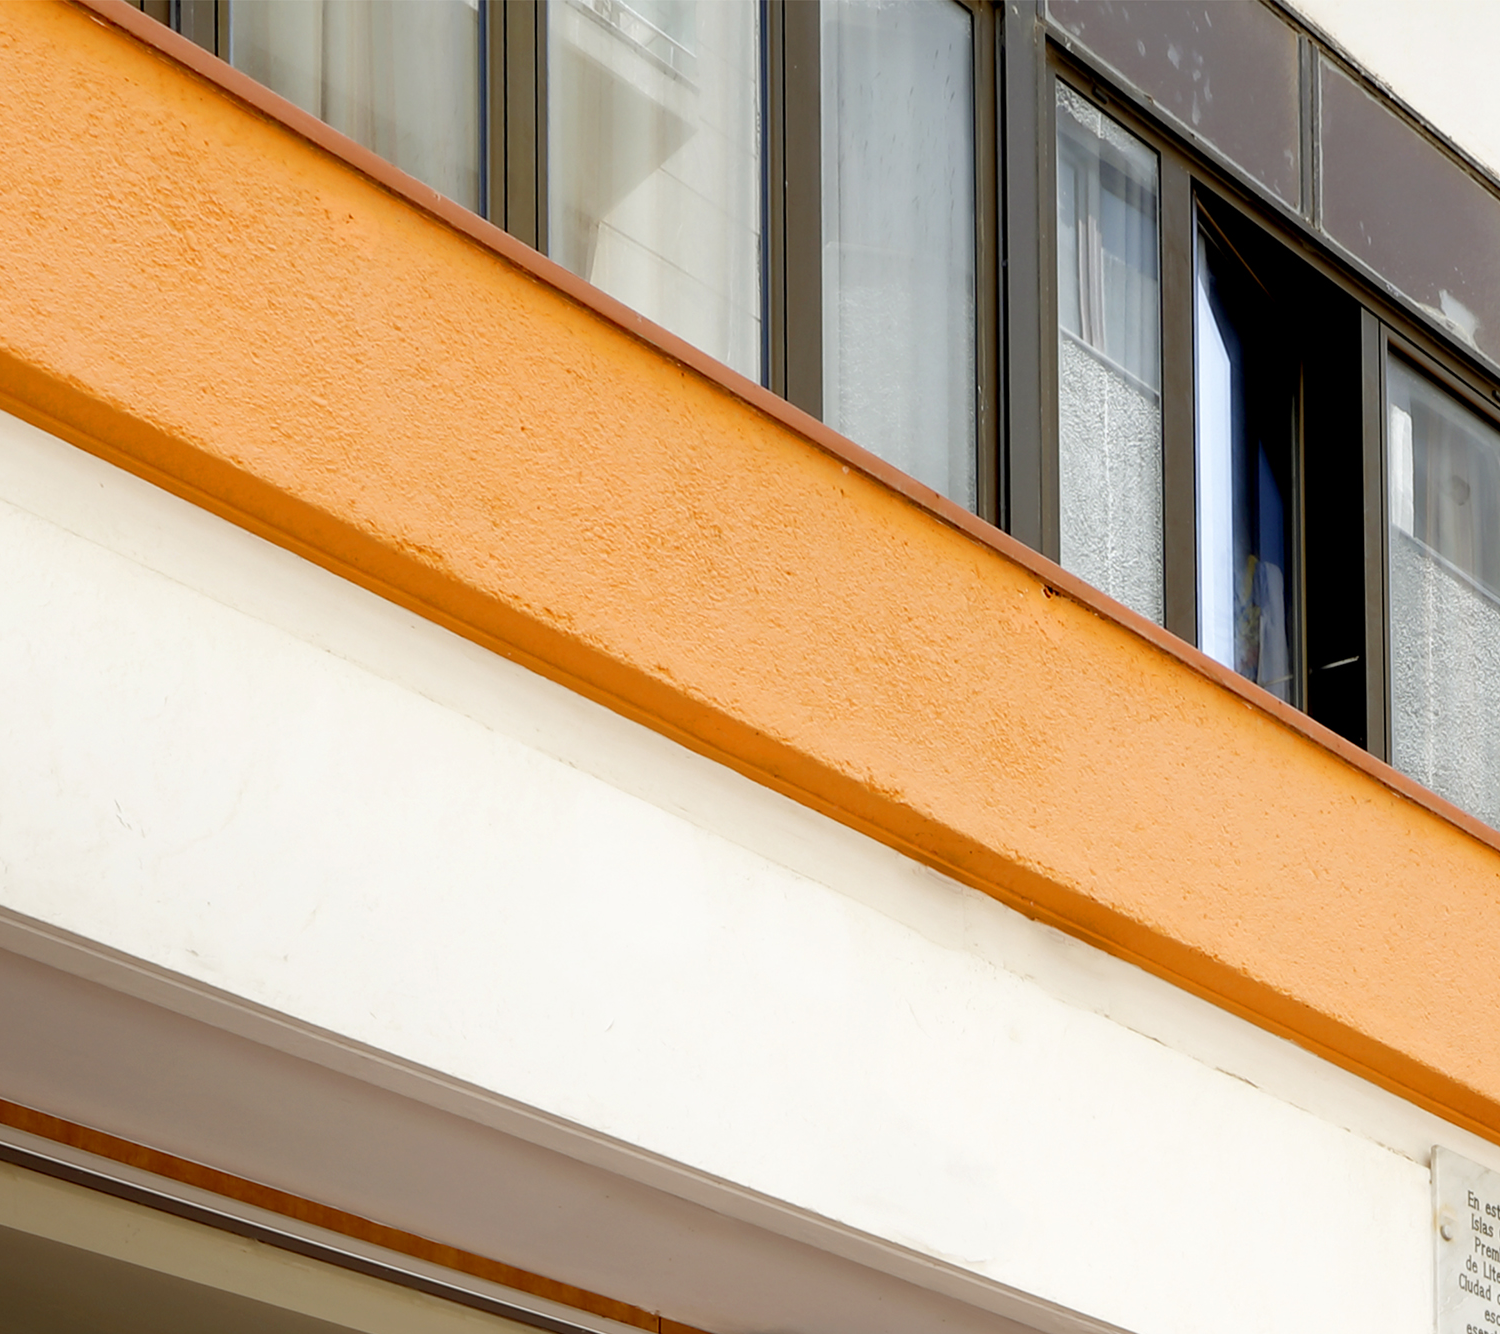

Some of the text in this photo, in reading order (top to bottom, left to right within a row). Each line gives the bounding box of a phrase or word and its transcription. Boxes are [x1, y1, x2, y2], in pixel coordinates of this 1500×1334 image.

[1466, 1190, 1481, 1212] En
[1470, 1212, 1495, 1238] Islas
[1464, 1254, 1479, 1274] de
[1457, 1272, 1493, 1302] Ciudad
